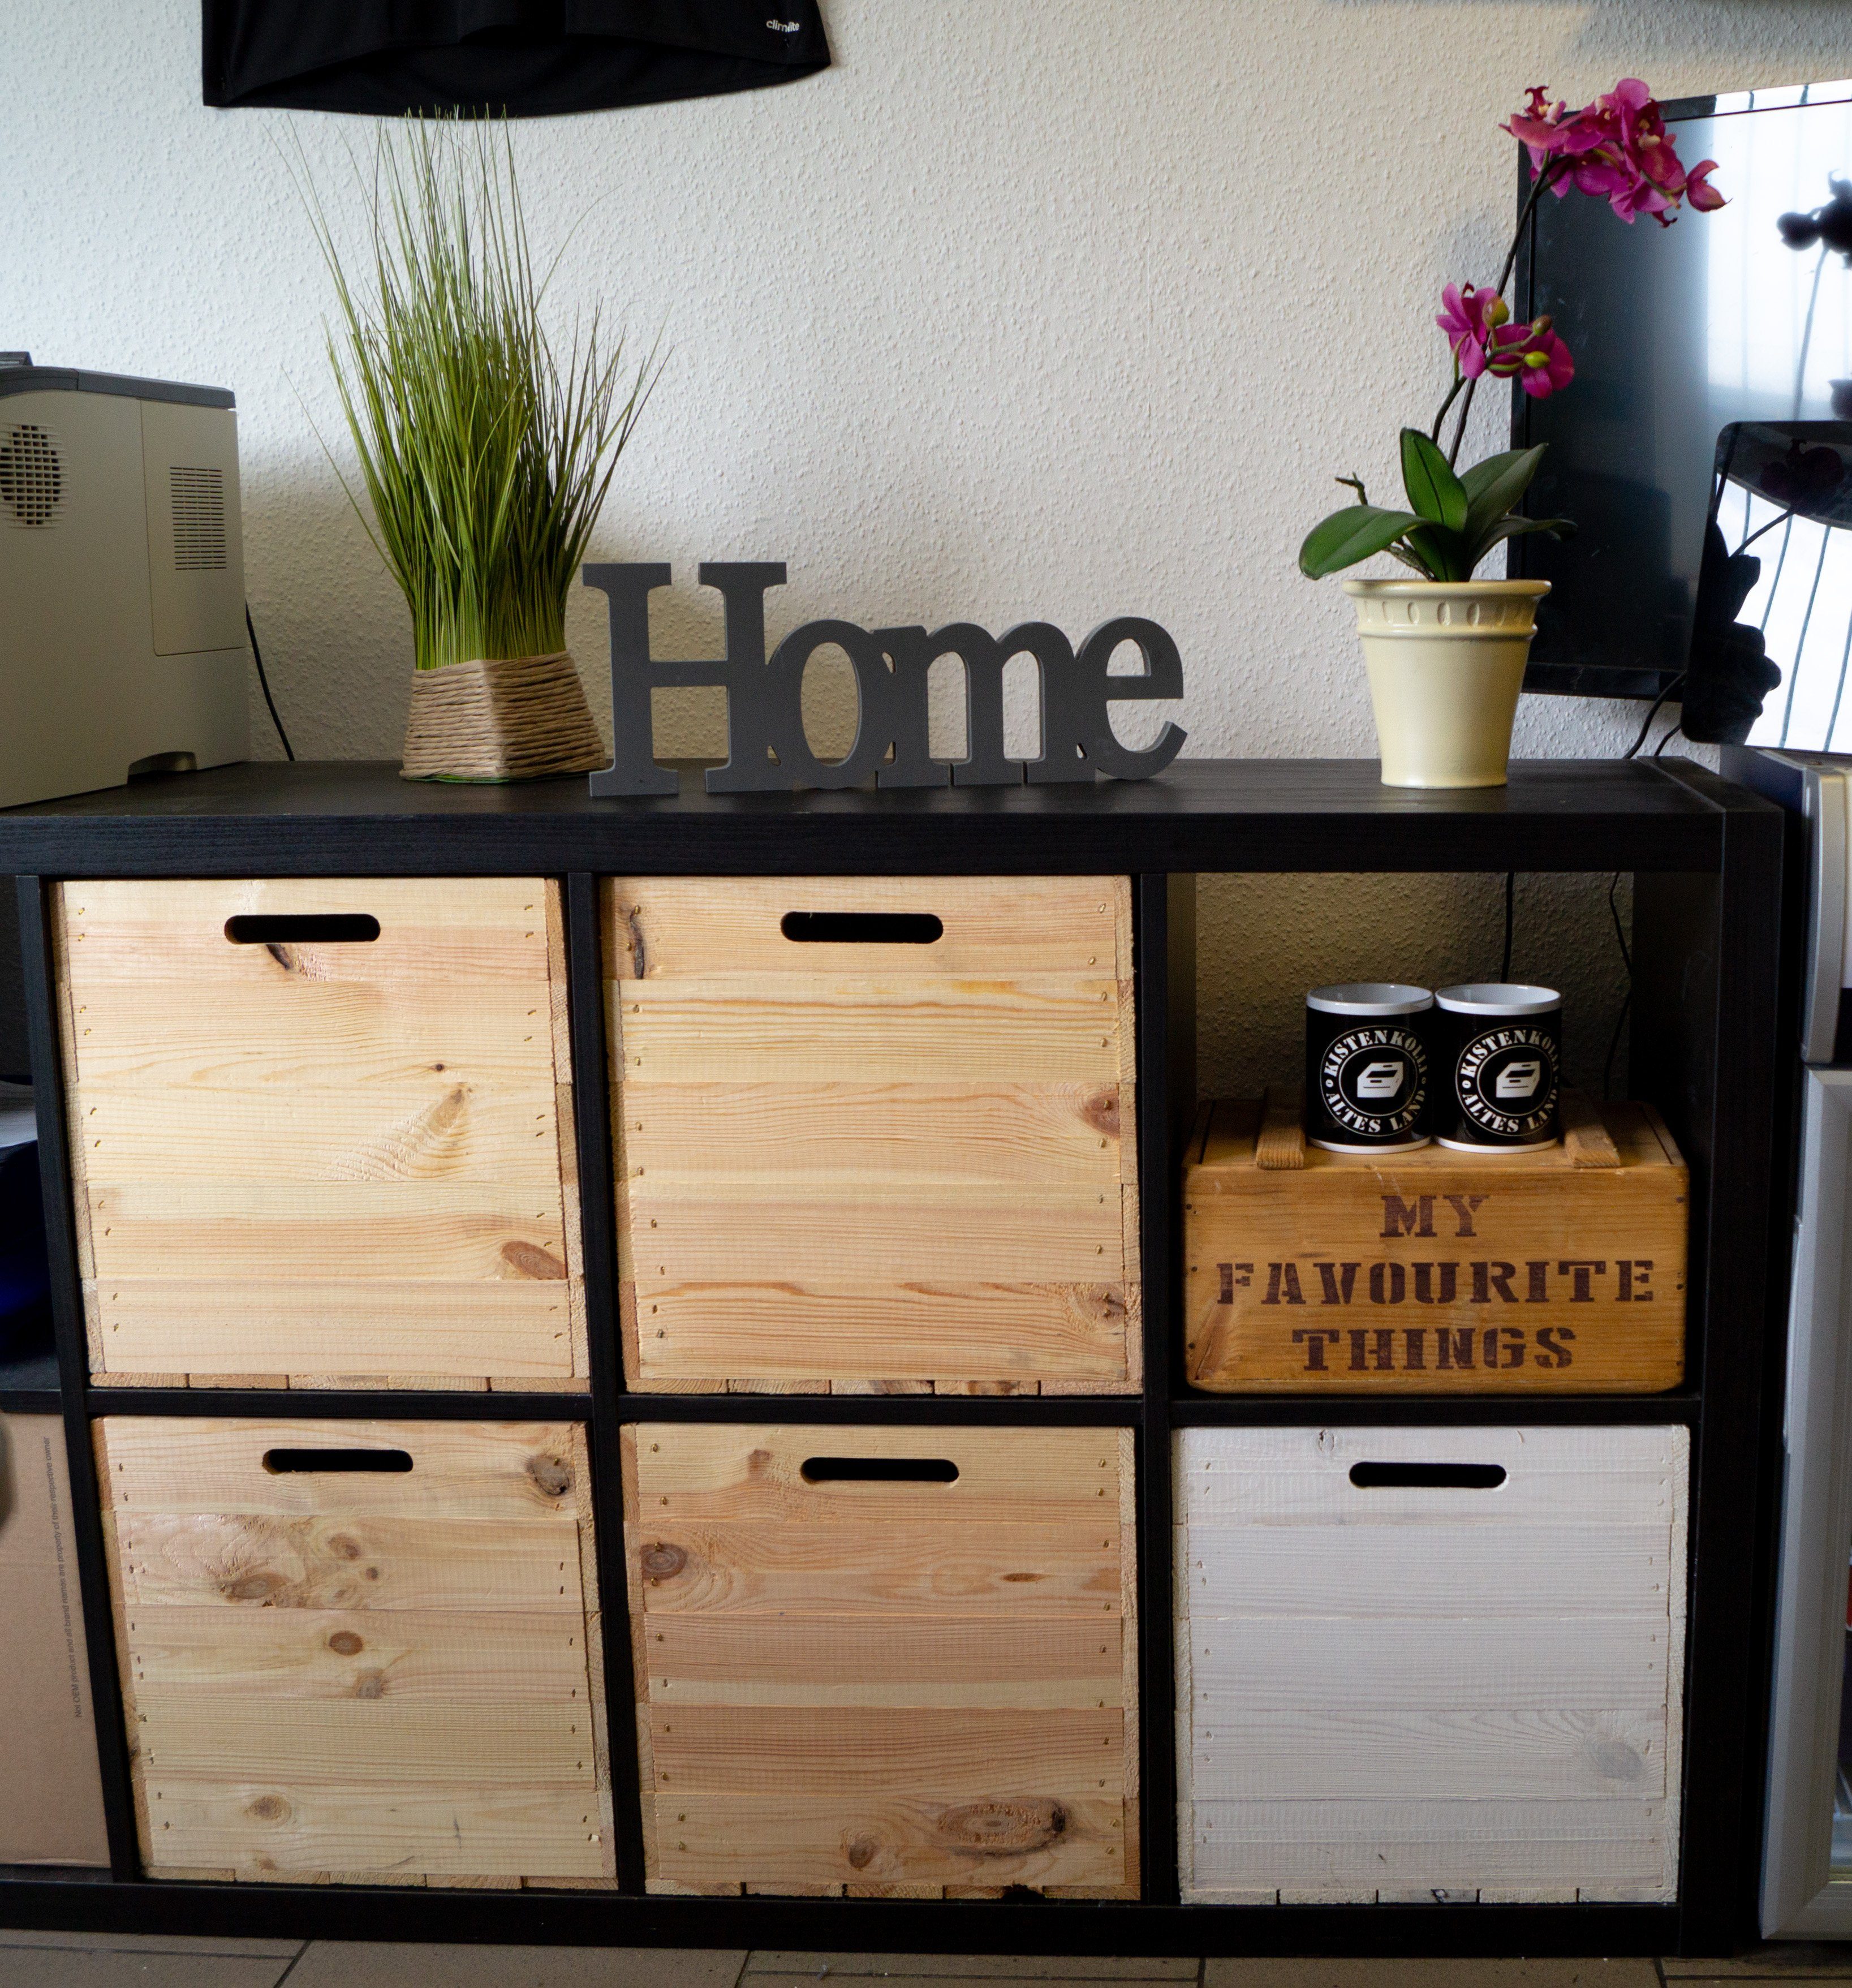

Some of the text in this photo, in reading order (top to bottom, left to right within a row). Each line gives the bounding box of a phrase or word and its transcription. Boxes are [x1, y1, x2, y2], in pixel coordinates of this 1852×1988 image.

[582, 561, 1188, 797] Home
[1326, 1089, 1426, 1133] ALTES LAND
[1462, 1088, 1557, 1133] ALTES LAND
[1379, 1194, 1491, 1238] MY
[1216, 1259, 1654, 1305] FAVOURITE
[1292, 1327, 1577, 1371] THINGS
[44, 1436, 52, 1461] owner
[47, 1462, 57, 1501] respective
[53, 1521, 60, 1530] of
[54, 1530, 64, 1562] property
[60, 1578, 68, 1604] names
[63, 1605, 71, 1626] brand
[68, 1654, 78, 1682] product
[72, 1684, 80, 1703] OEM
